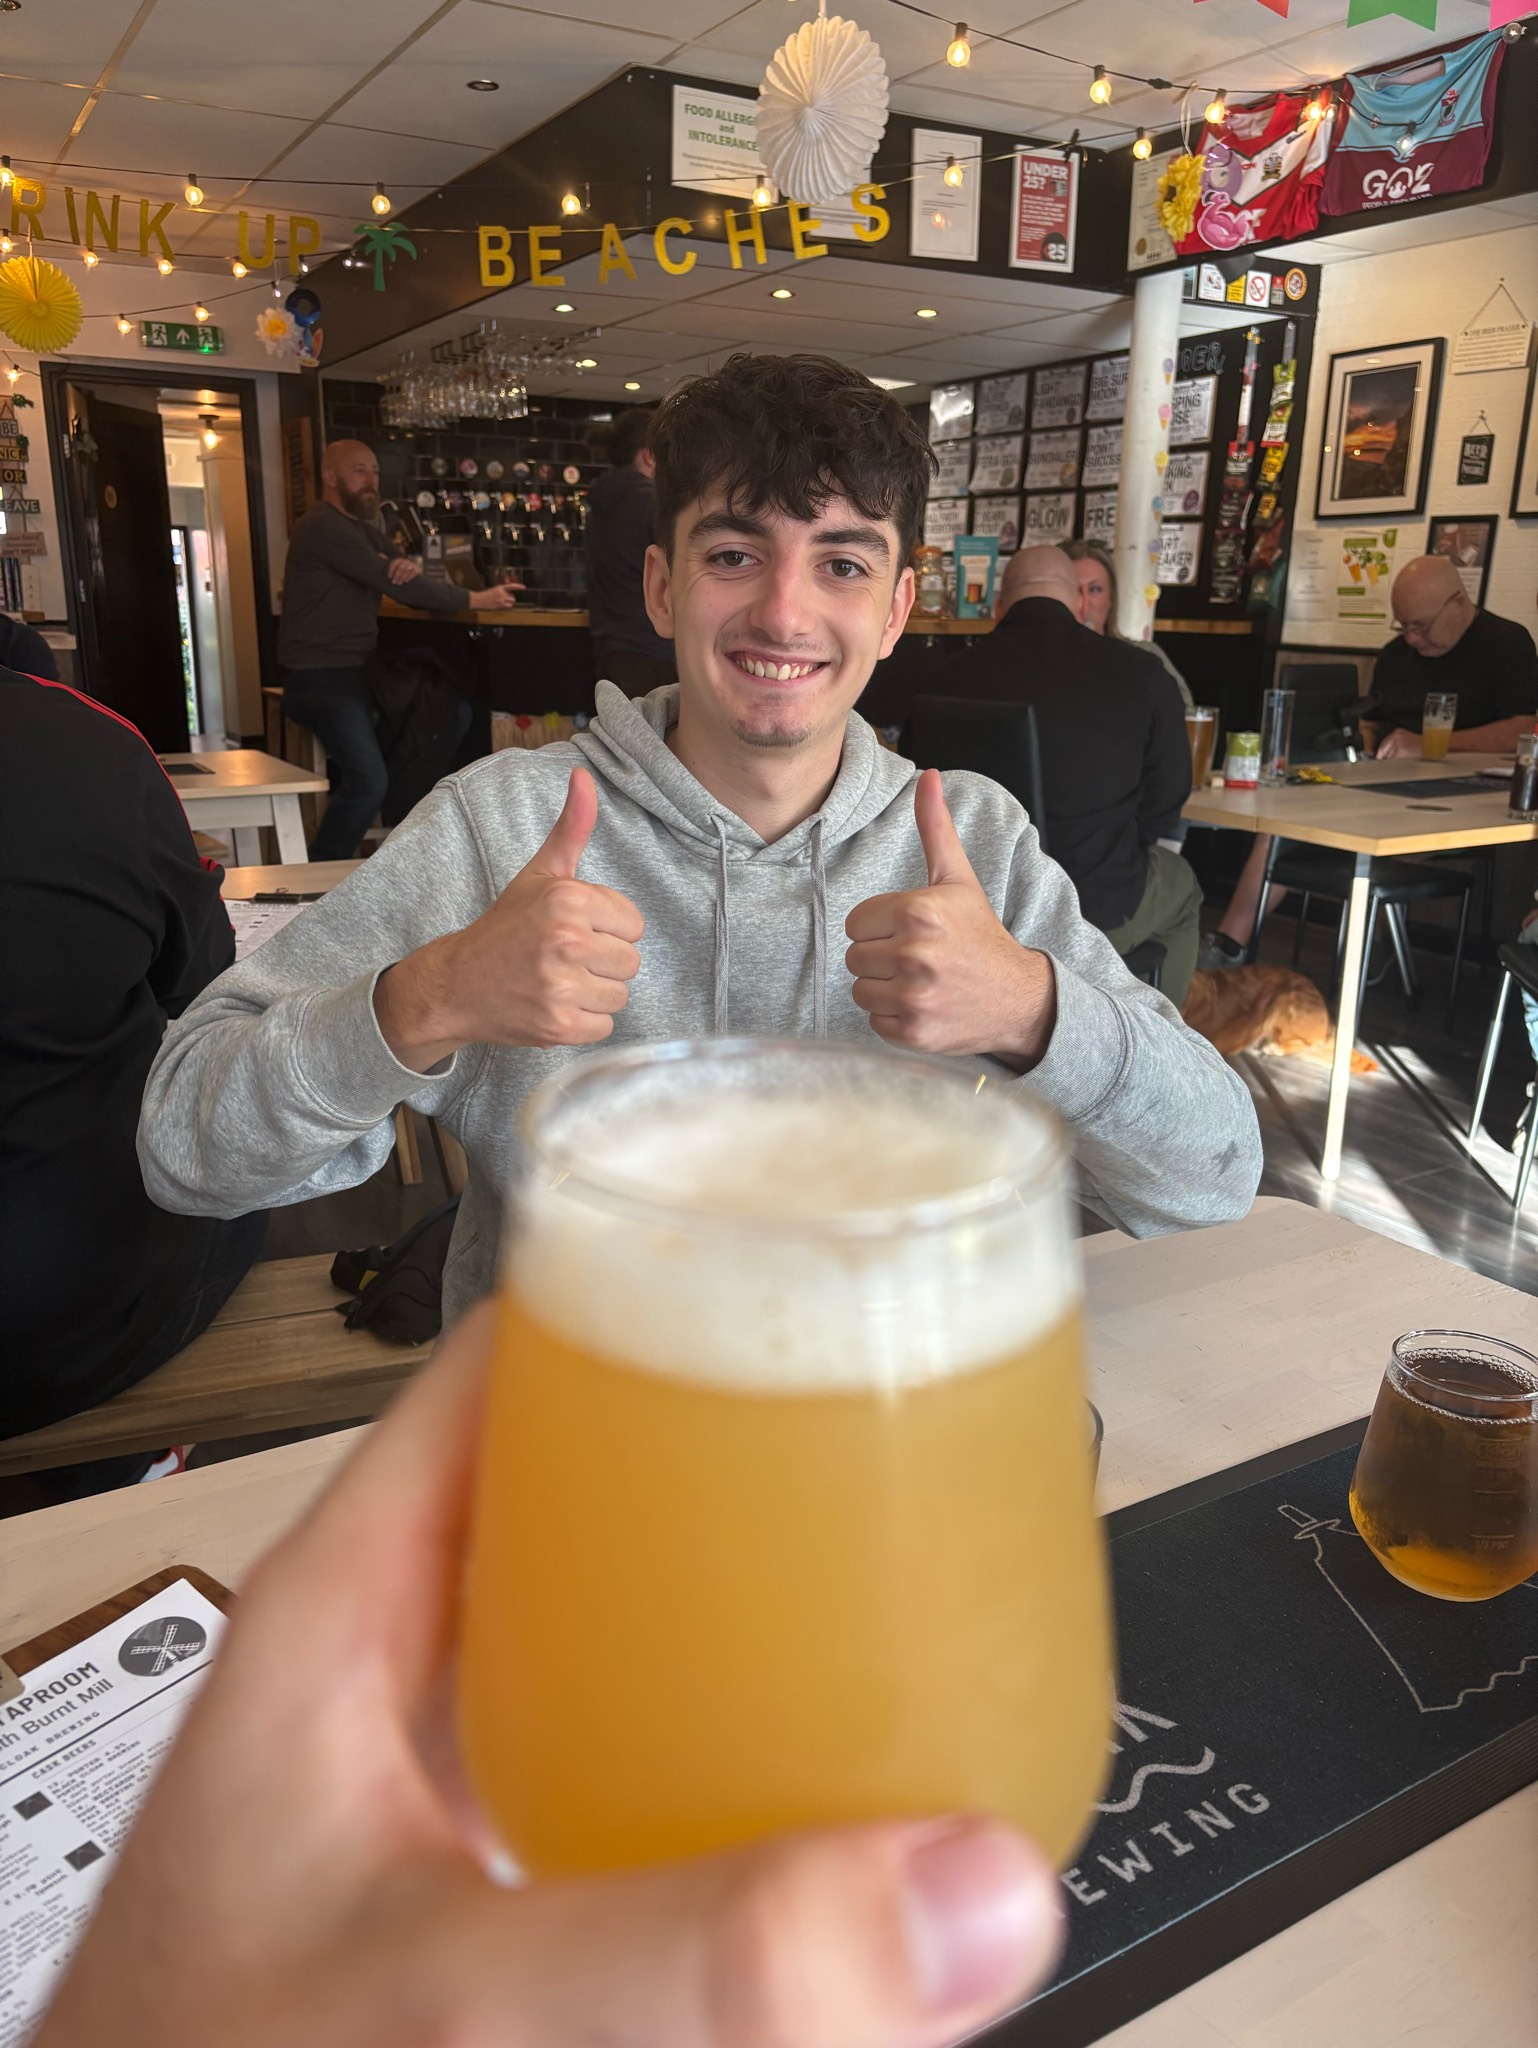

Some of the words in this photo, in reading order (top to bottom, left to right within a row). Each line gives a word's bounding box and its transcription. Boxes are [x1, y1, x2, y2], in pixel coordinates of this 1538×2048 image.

[684, 103, 713, 118] FOOD
[719, 125, 735, 133] and
[1023, 161, 1068, 180] UNDER
[1023, 175, 1047, 190] 25?
[11, 176, 177, 261] RINK
[238, 210, 321, 275] UP
[479, 183, 891, 287] BEACHES
[1047, 243, 1067, 260] 25
[2, 422, 17, 435] BE
[4, 472, 24, 481] OR
[1027, 507, 1070, 529] GLOW
[21, 1700, 78, 1734] Burnt
[77, 1678, 114, 1703] Mill
[32, 1759, 61, 1779] CASK
[62, 1739, 97, 1762] BEERS
[1061, 1783, 1271, 1906] EWING
